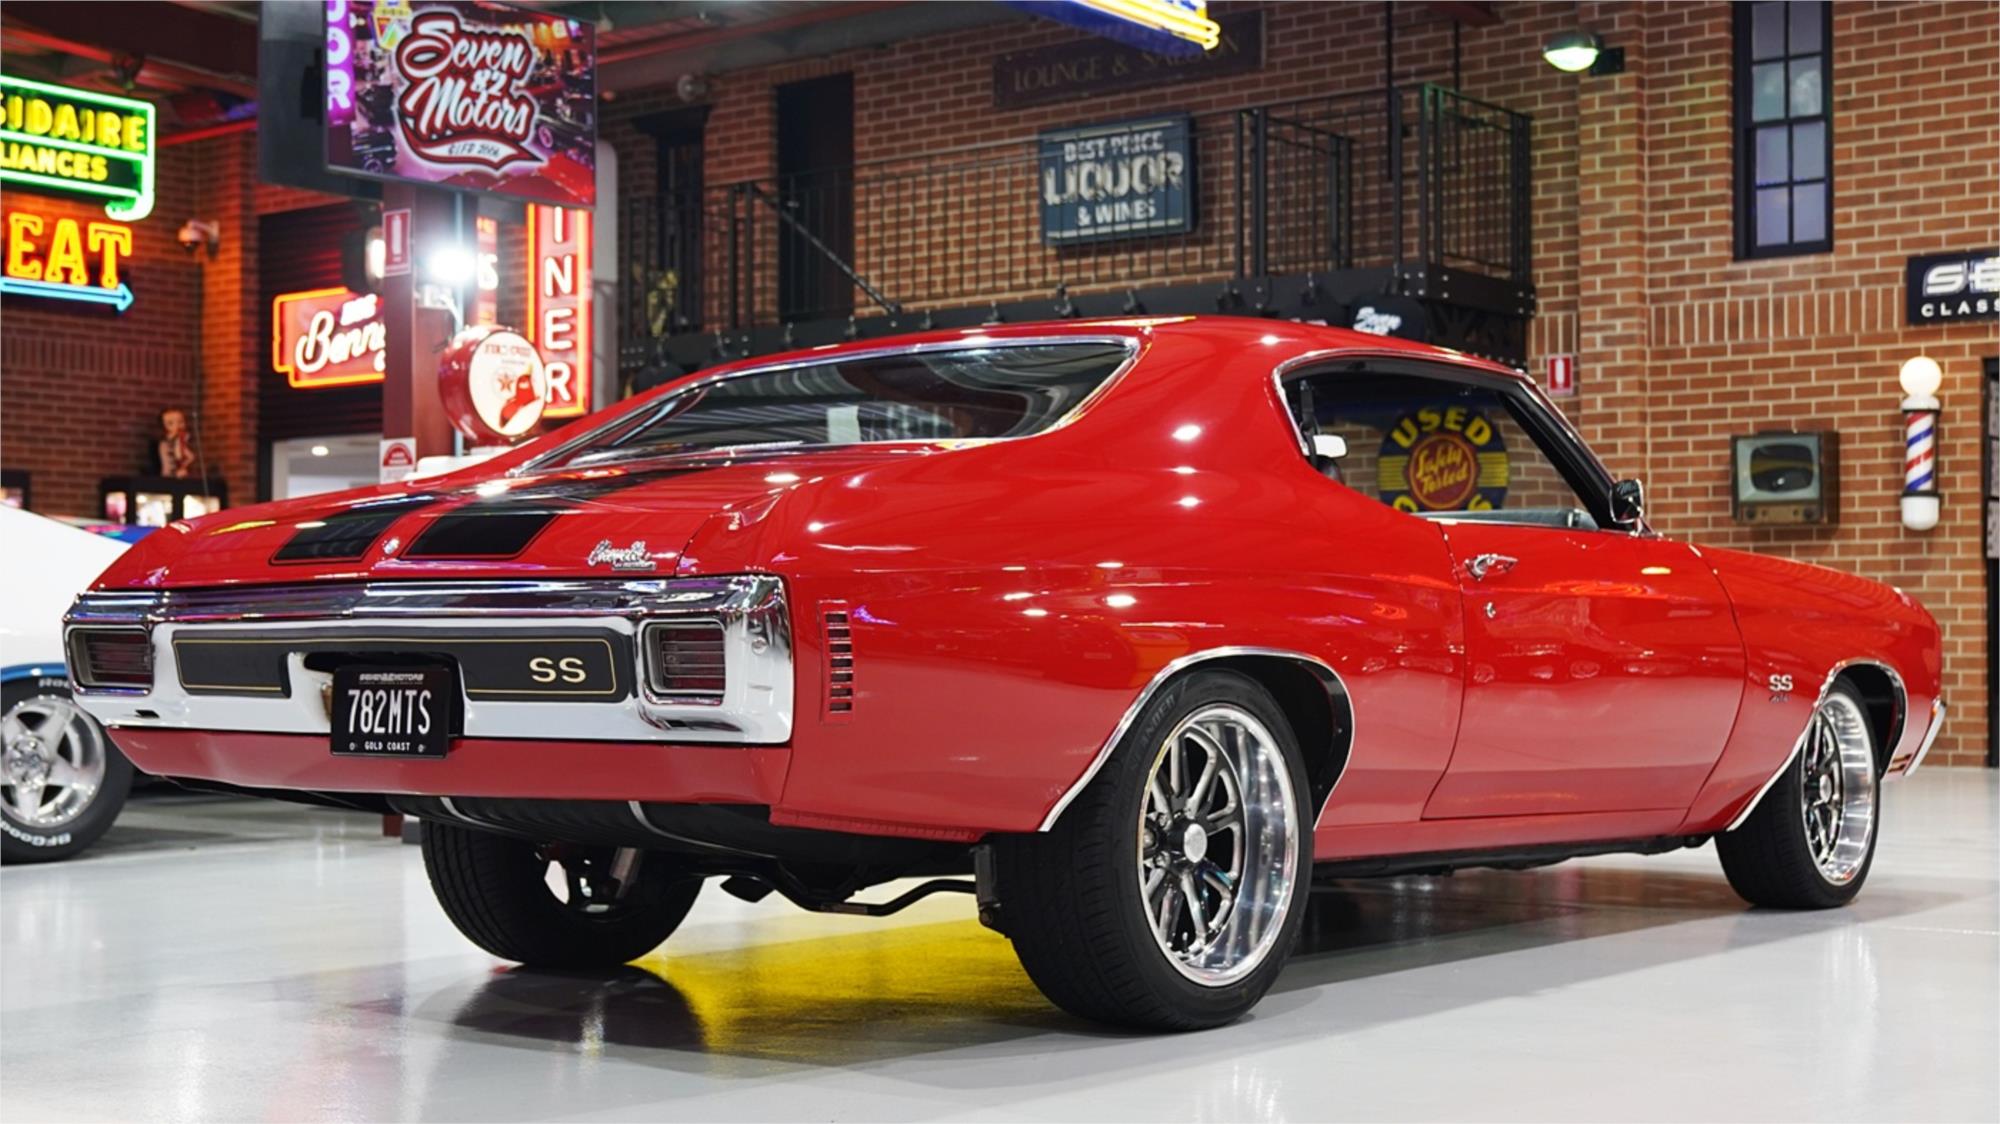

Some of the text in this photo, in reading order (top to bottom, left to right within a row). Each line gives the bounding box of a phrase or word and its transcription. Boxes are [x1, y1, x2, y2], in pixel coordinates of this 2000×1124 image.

[403, 20, 527, 78] Seven
[470, 69, 508, 97] 82
[1014, 56, 1103, 93] LOUNGE
[1112, 53, 1130, 77] &
[406, 77, 530, 135] Motors
[1064, 130, 1164, 162] BEST PRICE
[1044, 151, 1184, 205] LIQUOR
[1078, 198, 1156, 226] & WINES
[7, 211, 132, 290] EAT
[1391, 406, 1492, 448] USED
[529, 656, 587, 683] SS
[1769, 674, 1793, 691] SS
[347, 689, 432, 735] 782MTS
[364, 740, 411, 752] GOLD COAST
